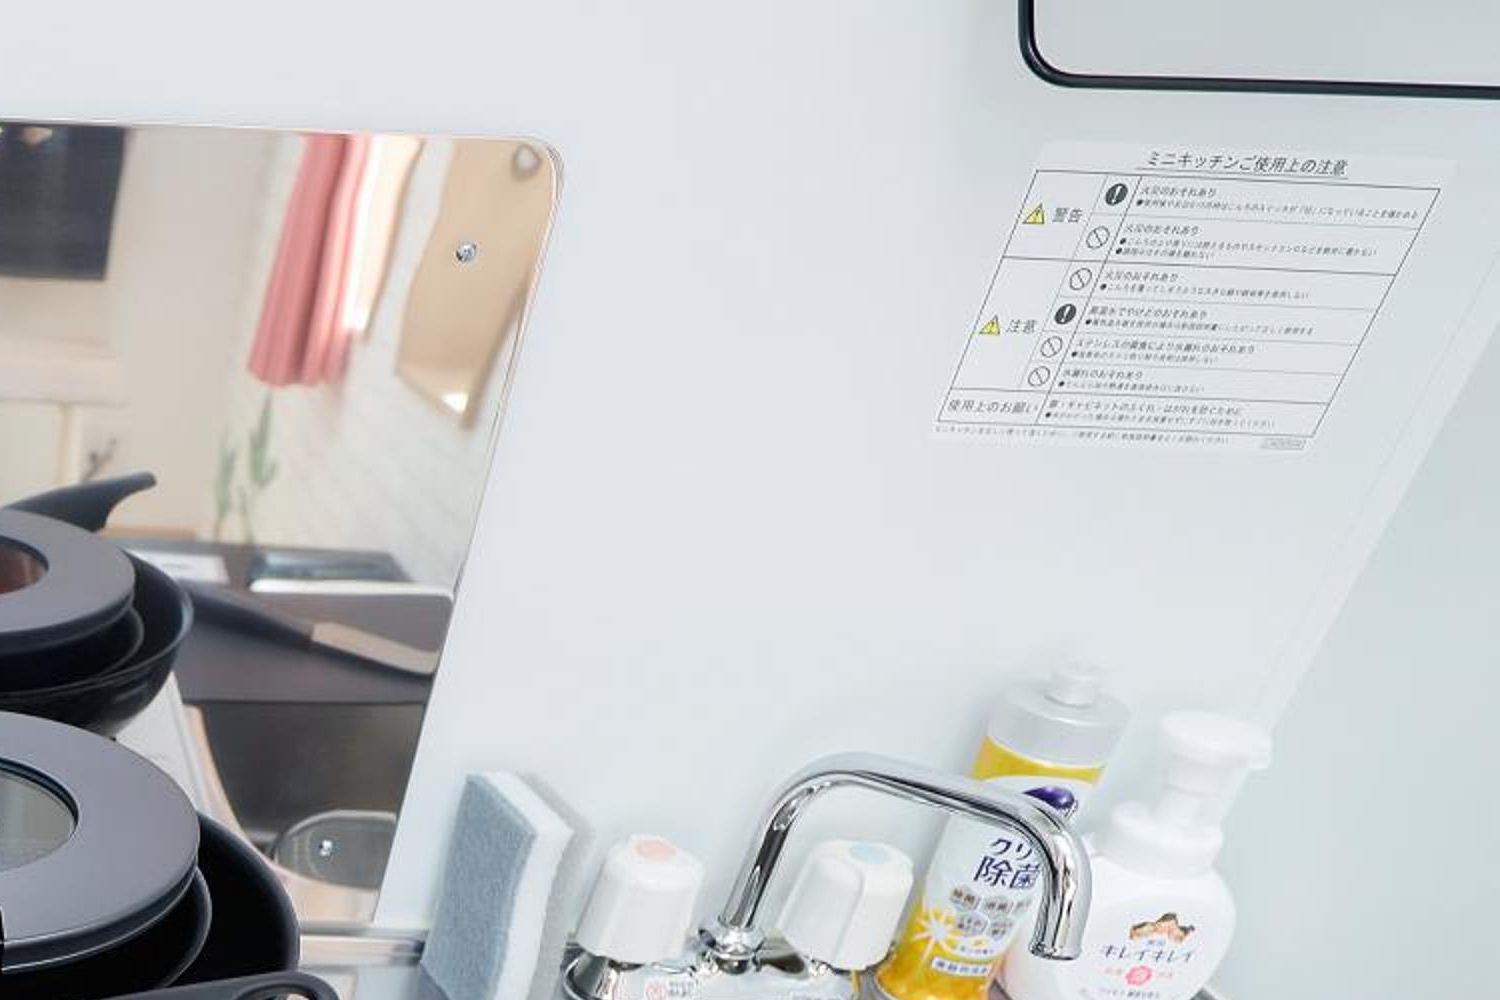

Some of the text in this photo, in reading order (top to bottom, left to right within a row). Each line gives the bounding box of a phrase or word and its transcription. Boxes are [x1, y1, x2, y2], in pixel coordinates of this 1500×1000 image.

[1149, 152, 1348, 175] ミニキッチンご使用上の注意
[990, 838, 1033, 860] クリ
[973, 856, 1040, 889] 除菌
